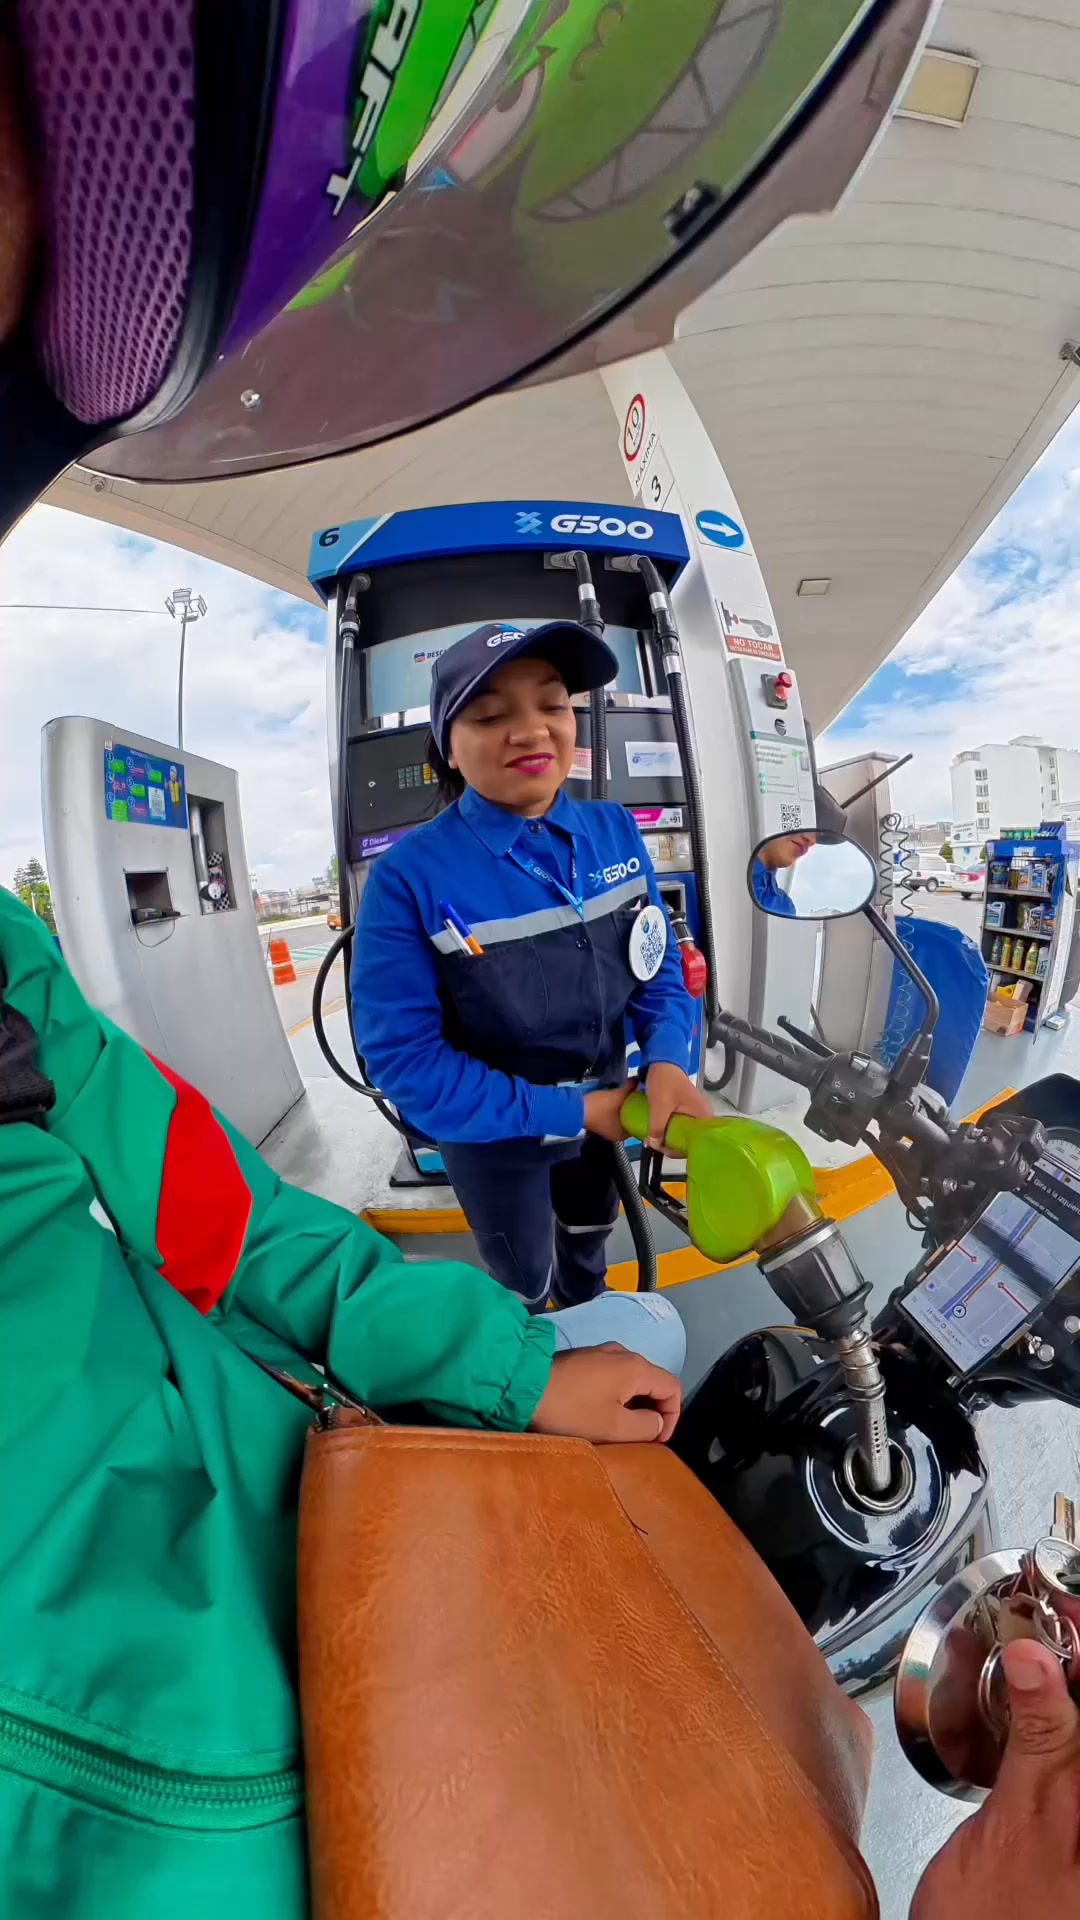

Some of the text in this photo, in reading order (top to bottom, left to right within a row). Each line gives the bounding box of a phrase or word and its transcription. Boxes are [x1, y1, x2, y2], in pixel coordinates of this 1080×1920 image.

[627, 406, 640, 441] 10
[651, 475, 662, 502] 3
[318, 527, 340, 547] 6
[550, 514, 654, 540] G500
[486, 631, 526, 648] G50
[733, 638, 774, 651] NO TOCAR
[369, 834, 389, 846] Diesel
[603, 857, 640, 884] G500
